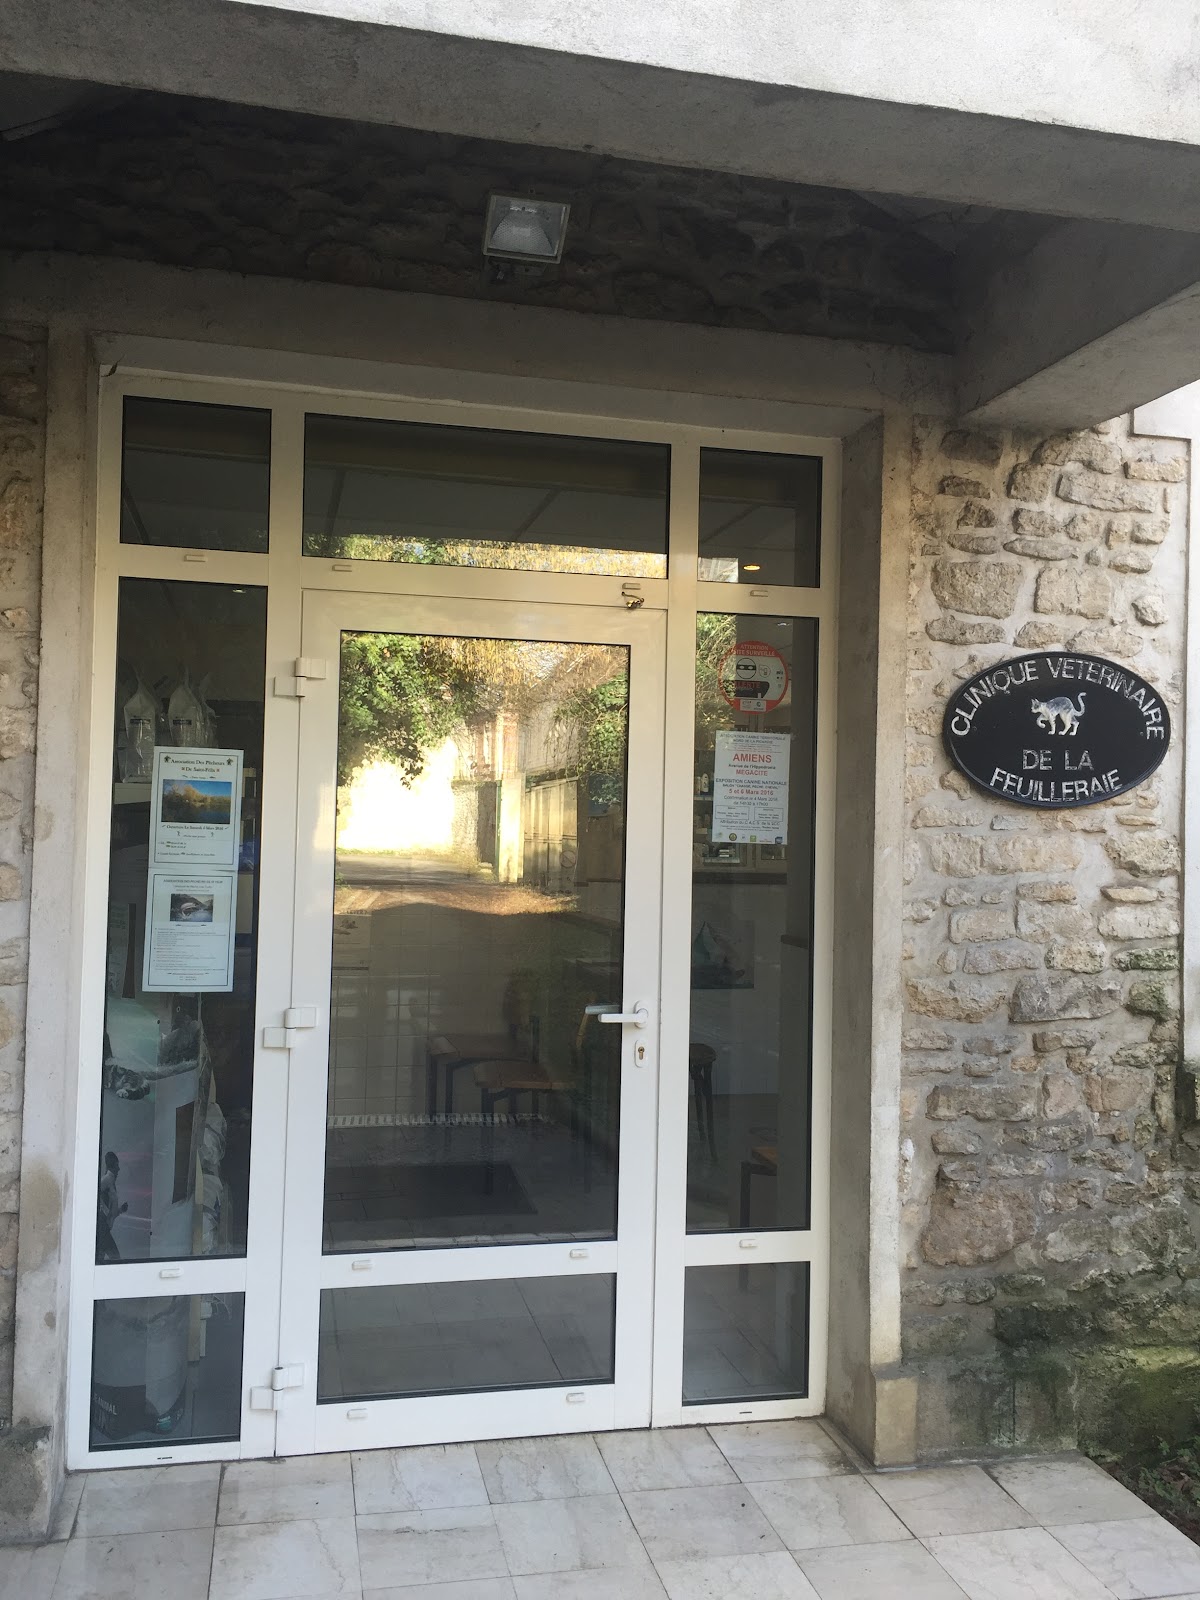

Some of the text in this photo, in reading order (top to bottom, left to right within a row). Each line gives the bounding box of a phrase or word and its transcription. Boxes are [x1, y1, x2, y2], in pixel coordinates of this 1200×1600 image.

[951, 657, 1165, 740] CLINIQUE VETERINAIRE
[733, 753, 772, 763] AMIENS
[1022, 749, 1094, 771] DE LA
[989, 767, 1123, 802] FEUILLERAIE
